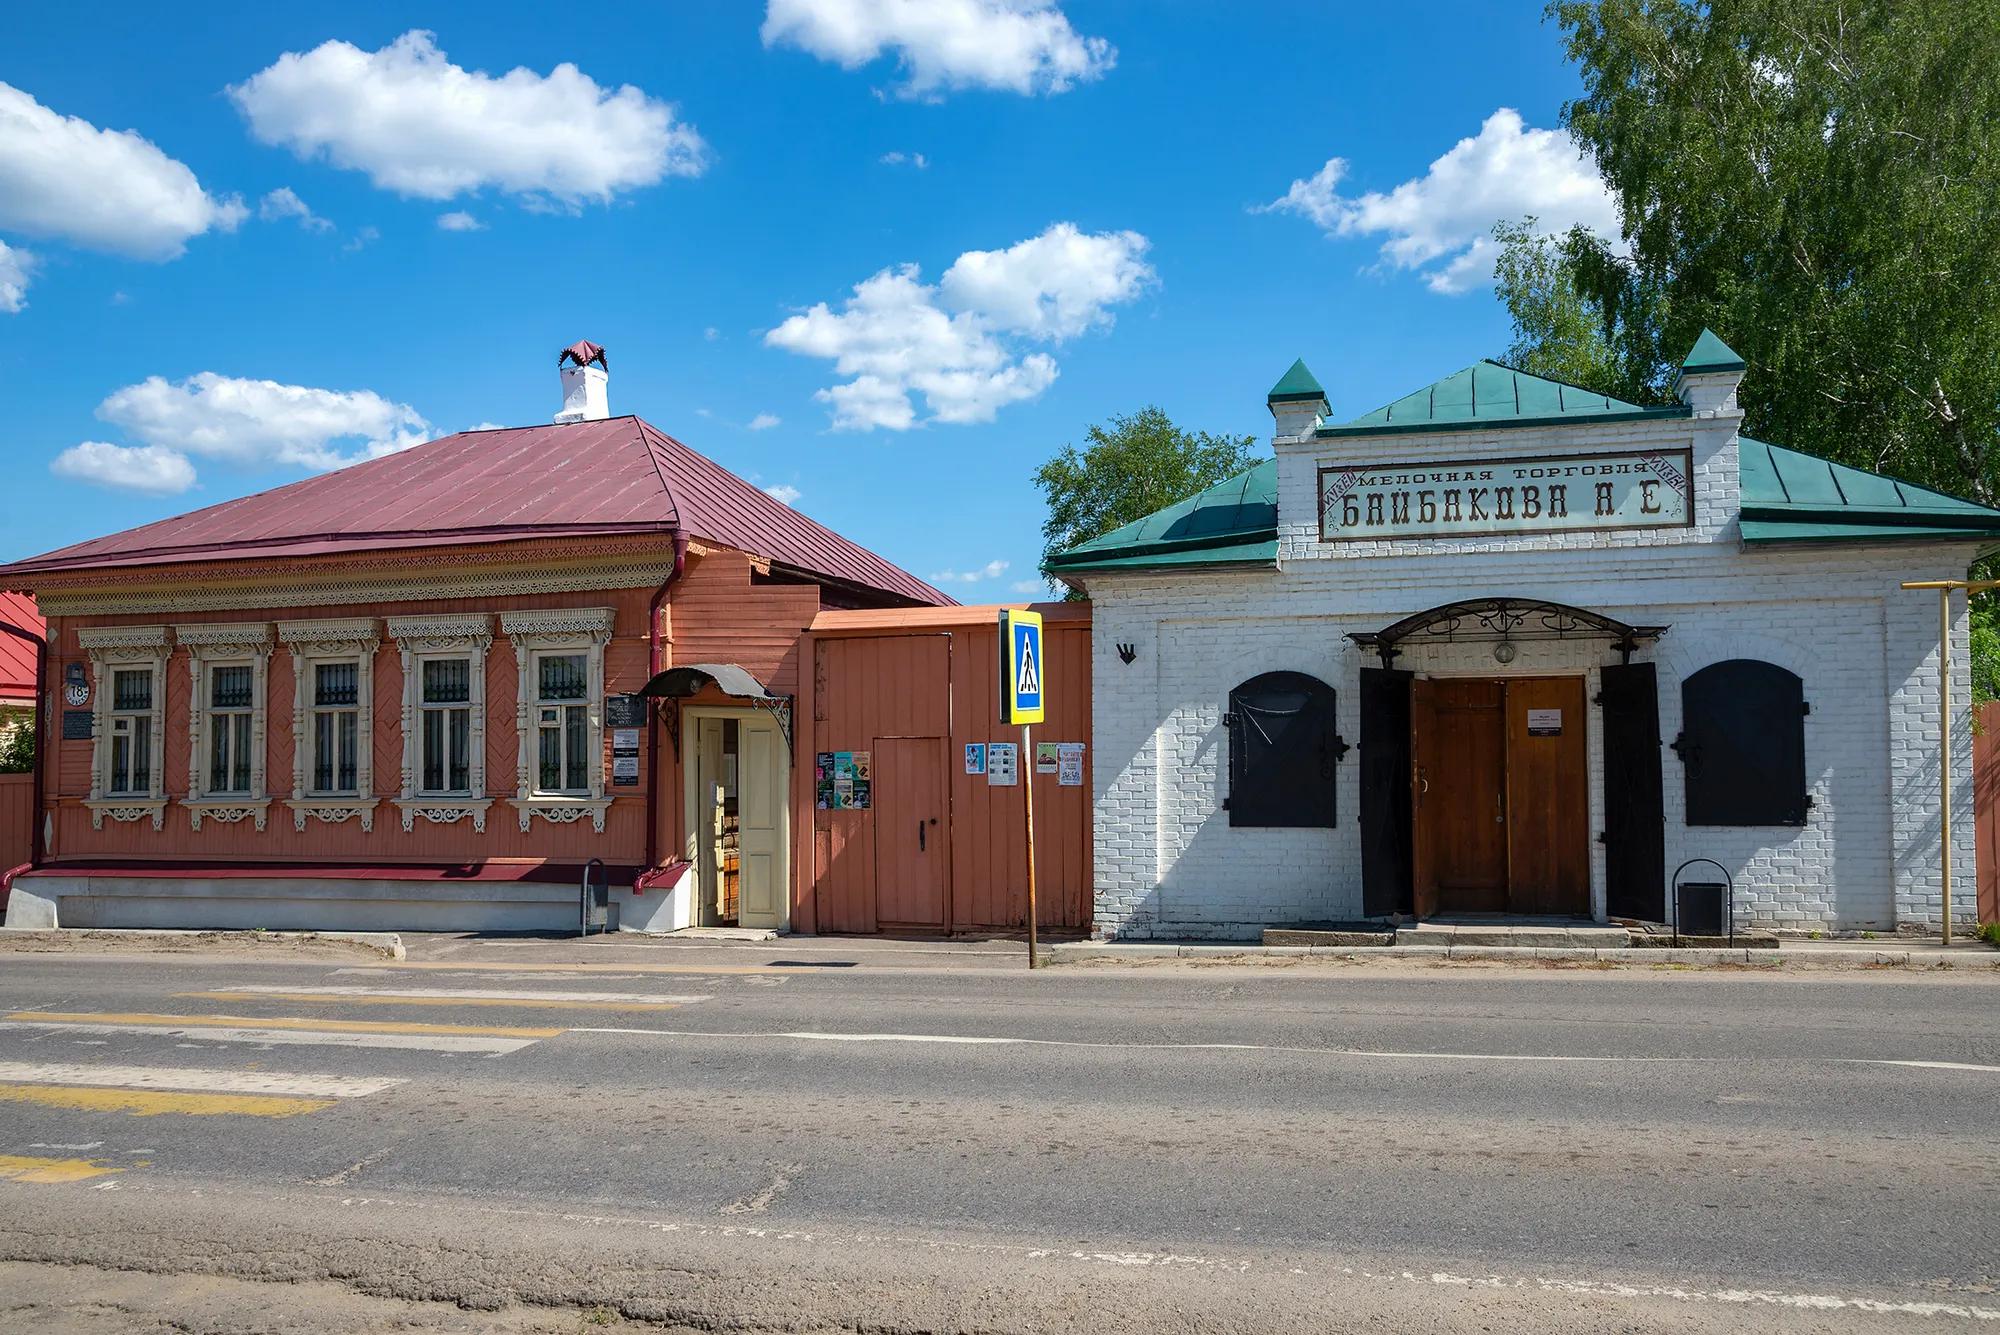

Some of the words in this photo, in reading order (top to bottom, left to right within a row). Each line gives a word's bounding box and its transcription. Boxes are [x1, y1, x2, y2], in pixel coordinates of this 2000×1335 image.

[1357, 470, 1493, 487] МЕЛОЧНАЯ
[1513, 462, 1650, 479] ТОРГОВЛЯ
[1340, 484, 1568, 527] БАЙБАКОВА
